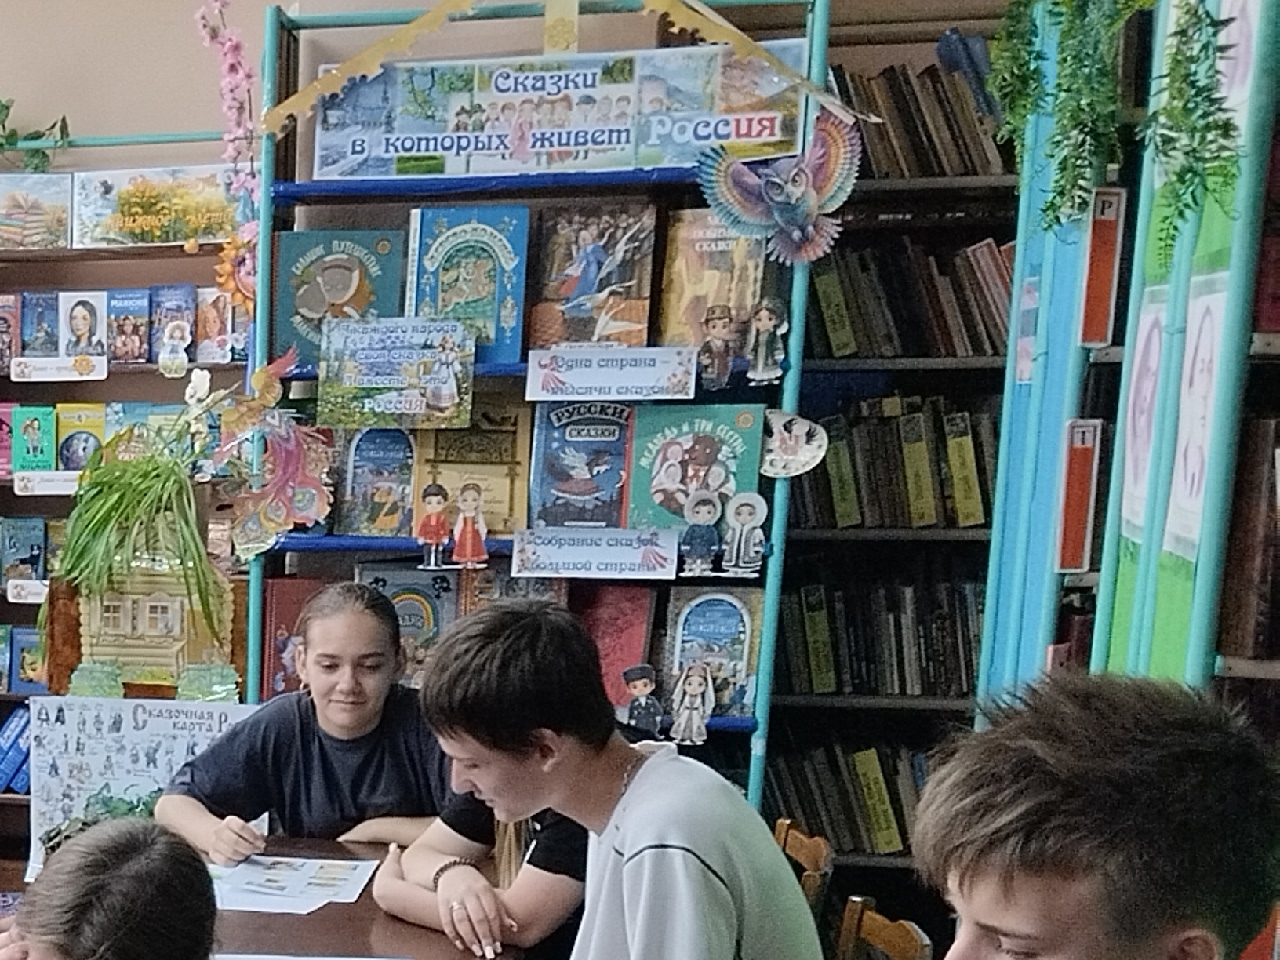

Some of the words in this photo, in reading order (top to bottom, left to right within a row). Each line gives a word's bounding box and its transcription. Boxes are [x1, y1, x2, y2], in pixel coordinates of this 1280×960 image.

[493, 69, 598, 96] Сказки
[350, 138, 367, 155] в
[384, 132, 510, 157] которых
[529, 126, 632, 150] живет
[647, 115, 777, 146] Россия
[1099, 200, 1112, 216] Р
[597, 357, 657, 370] страна
[553, 403, 628, 425] РУССКИ
[568, 427, 618, 439] СКАЗКИ
[694, 418, 714, 433] ТРИ
[533, 534, 603, 549] Собрание
